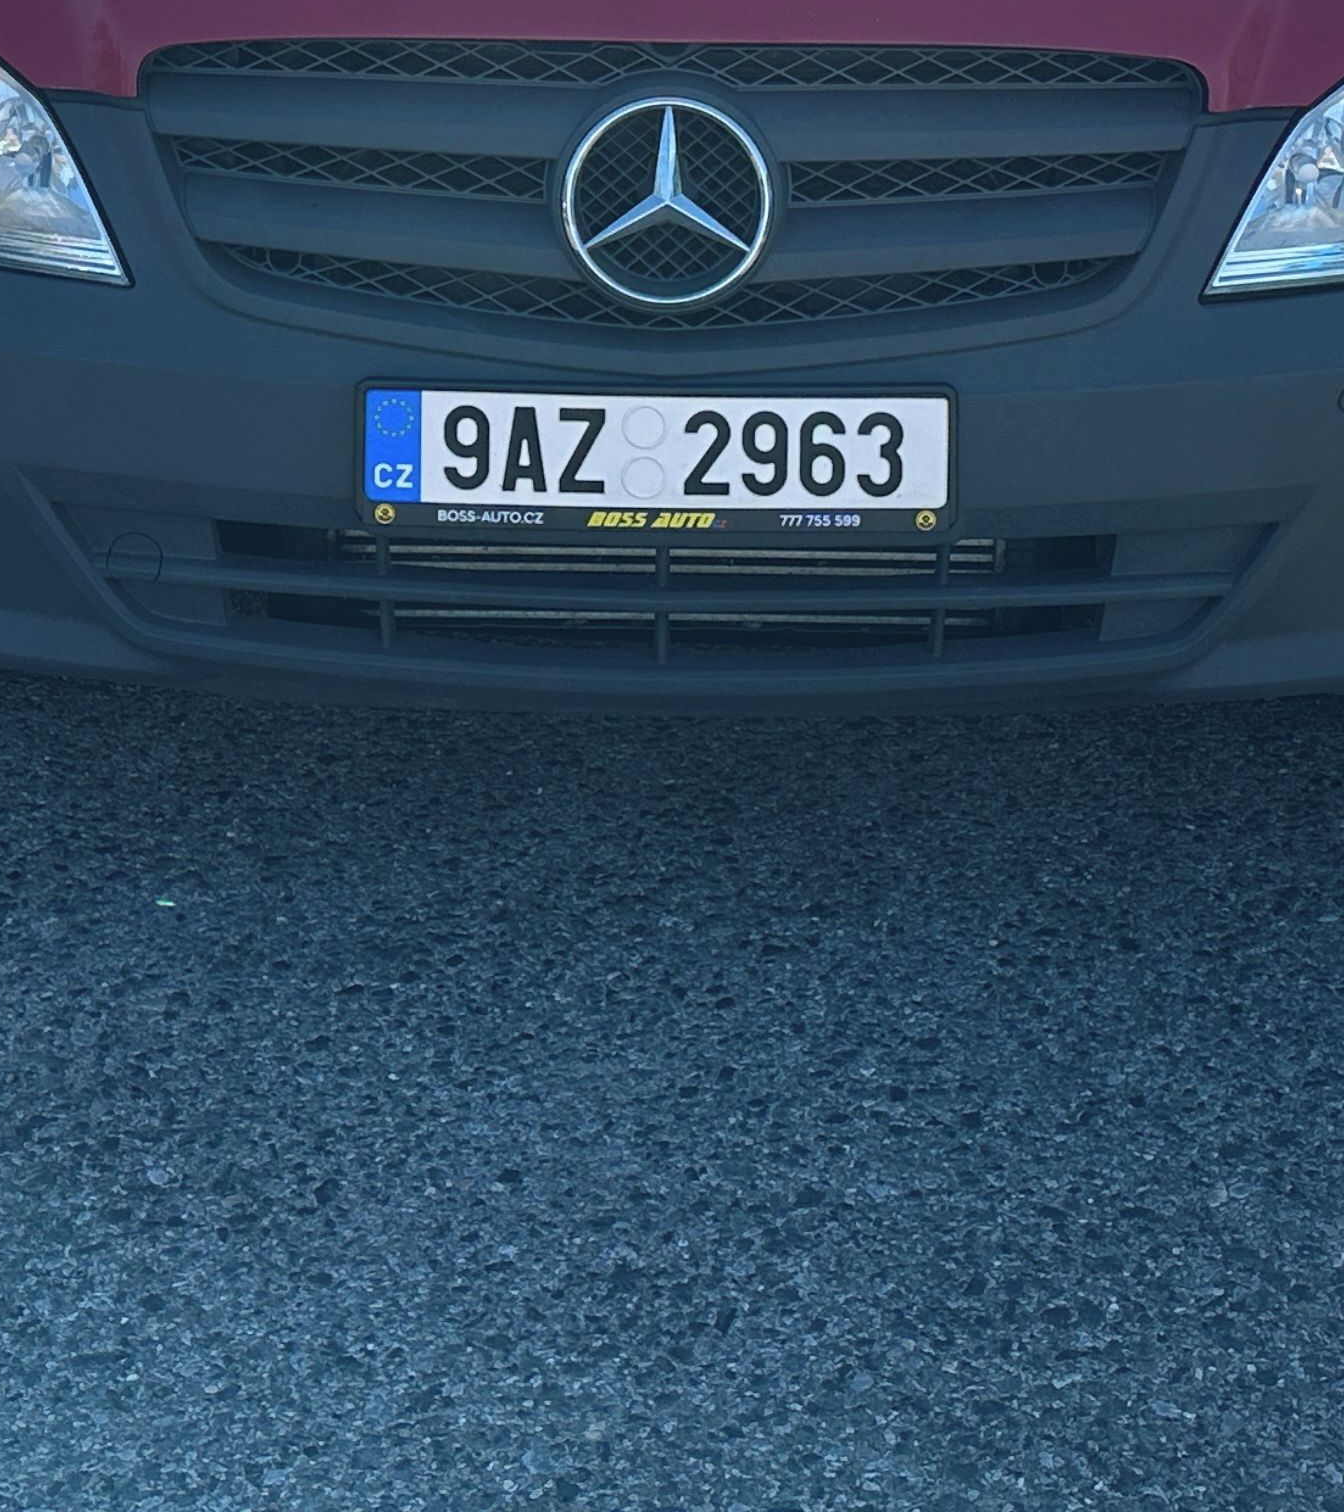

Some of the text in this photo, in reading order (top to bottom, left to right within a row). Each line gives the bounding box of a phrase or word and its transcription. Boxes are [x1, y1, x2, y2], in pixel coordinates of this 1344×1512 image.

[443, 404, 903, 497] 9AZ 2963
[374, 463, 413, 488] CZ
[437, 509, 544, 525] BOSS-AUTO.CZ
[587, 511, 648, 528] BOSS
[651, 512, 716, 529] AUTO
[779, 514, 803, 527] 777
[806, 514, 831, 527] 755
[834, 514, 861, 528] 599
